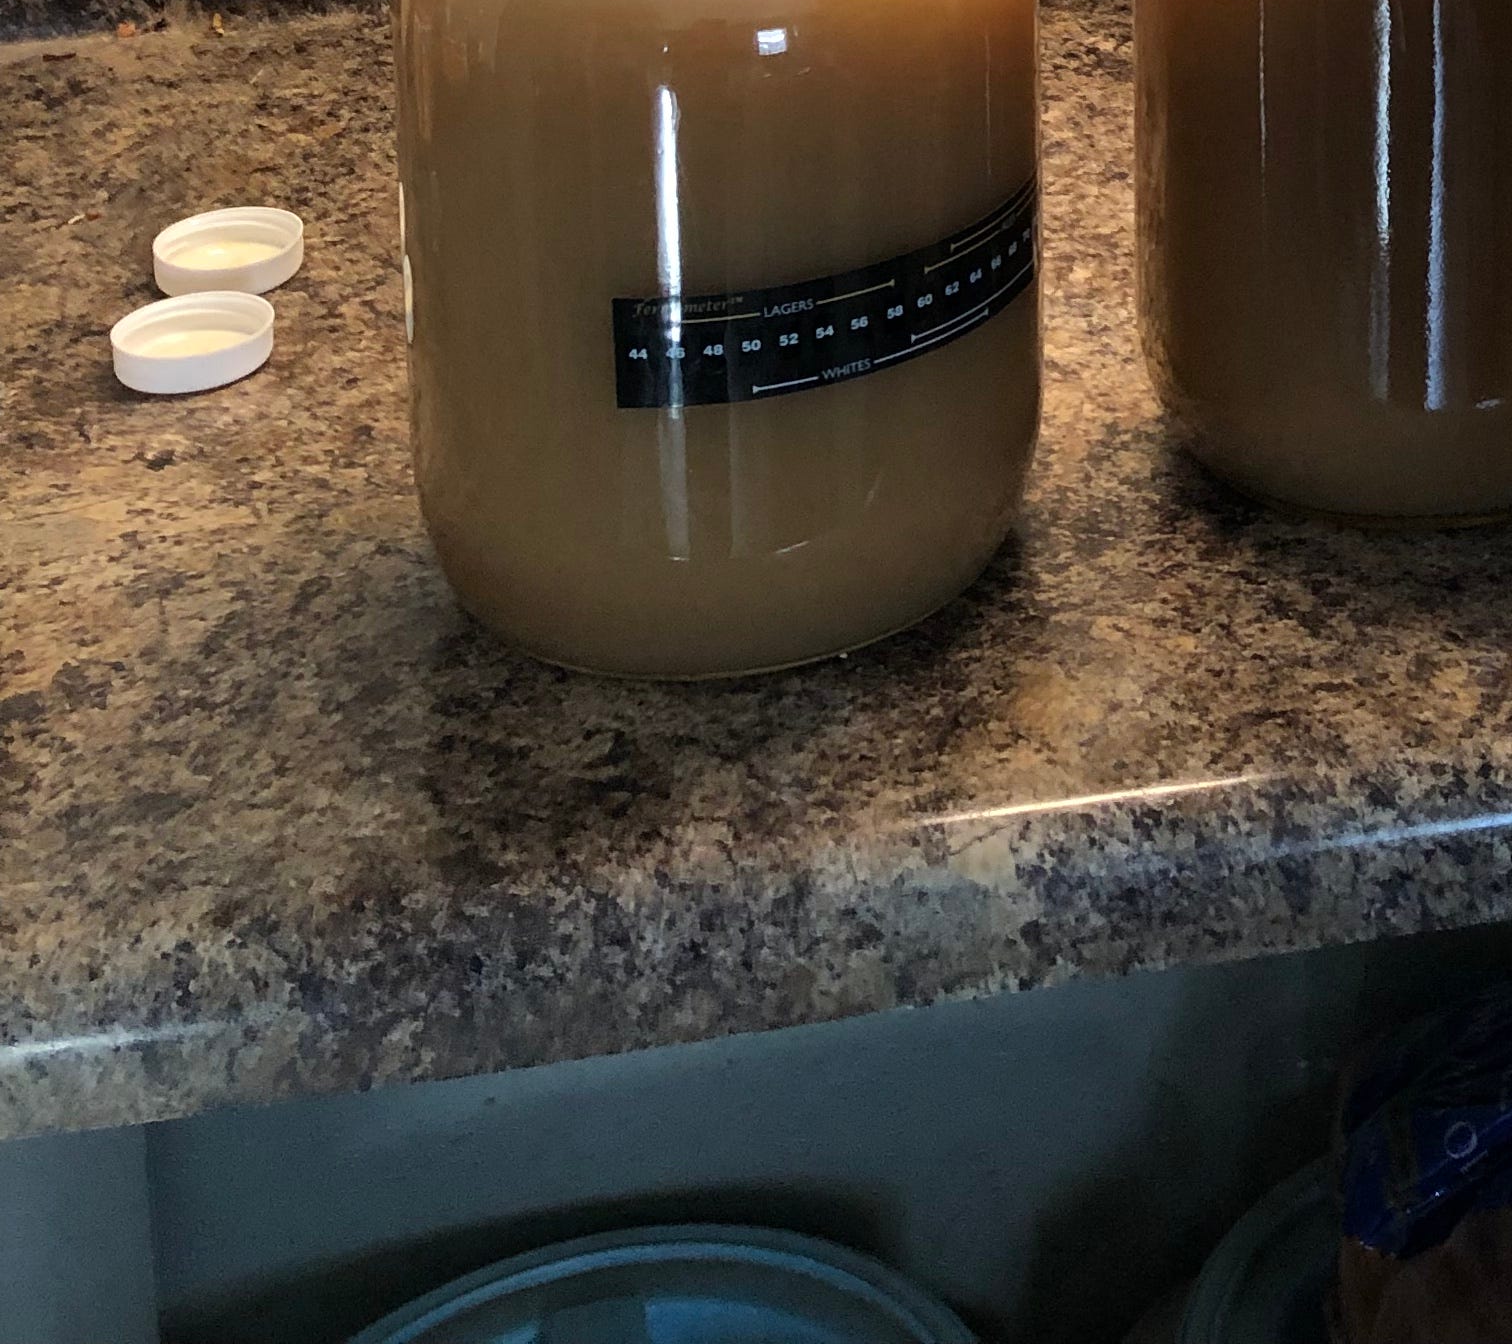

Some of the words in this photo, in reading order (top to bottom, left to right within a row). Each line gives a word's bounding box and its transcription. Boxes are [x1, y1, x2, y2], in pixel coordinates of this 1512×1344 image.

[629, 348, 649, 361] 44
[703, 343, 725, 357] 48
[741, 339, 762, 354] 50
[778, 332, 799, 347] 52
[815, 324, 835, 339] 54
[850, 315, 869, 331] 56
[886, 303, 904, 320] 58
[916, 292, 934, 309] 60
[944, 280, 960, 297] 62
[969, 268, 983, 285] 64
[763, 297, 815, 318] LAGERS
[821, 358, 871, 380] WHITES
